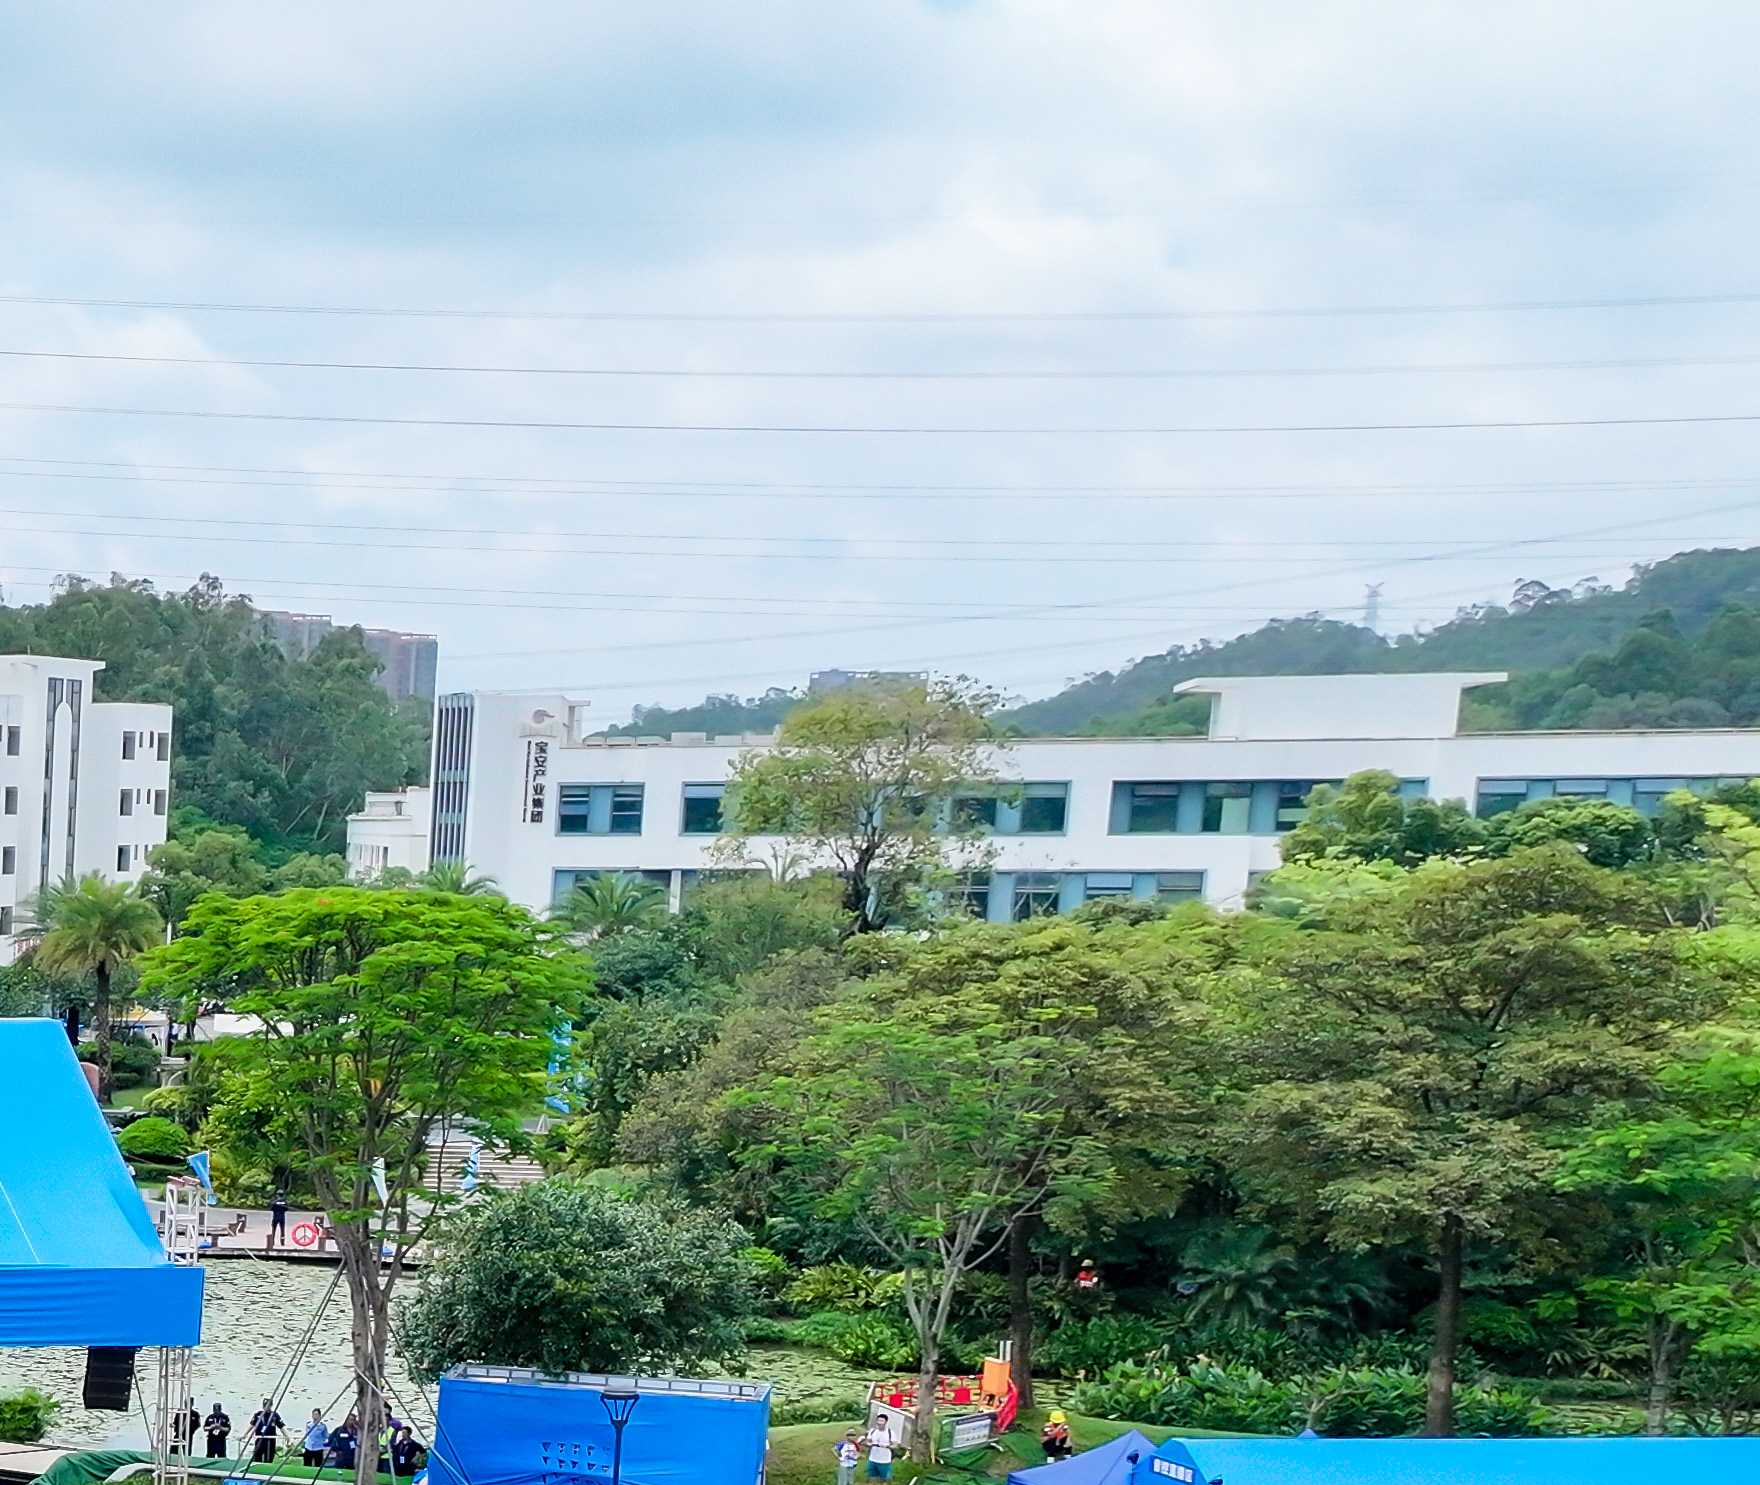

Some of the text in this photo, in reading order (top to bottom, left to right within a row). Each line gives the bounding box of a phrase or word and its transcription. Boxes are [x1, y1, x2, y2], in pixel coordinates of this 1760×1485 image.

[530, 741, 548, 823] 宝安产业集团
